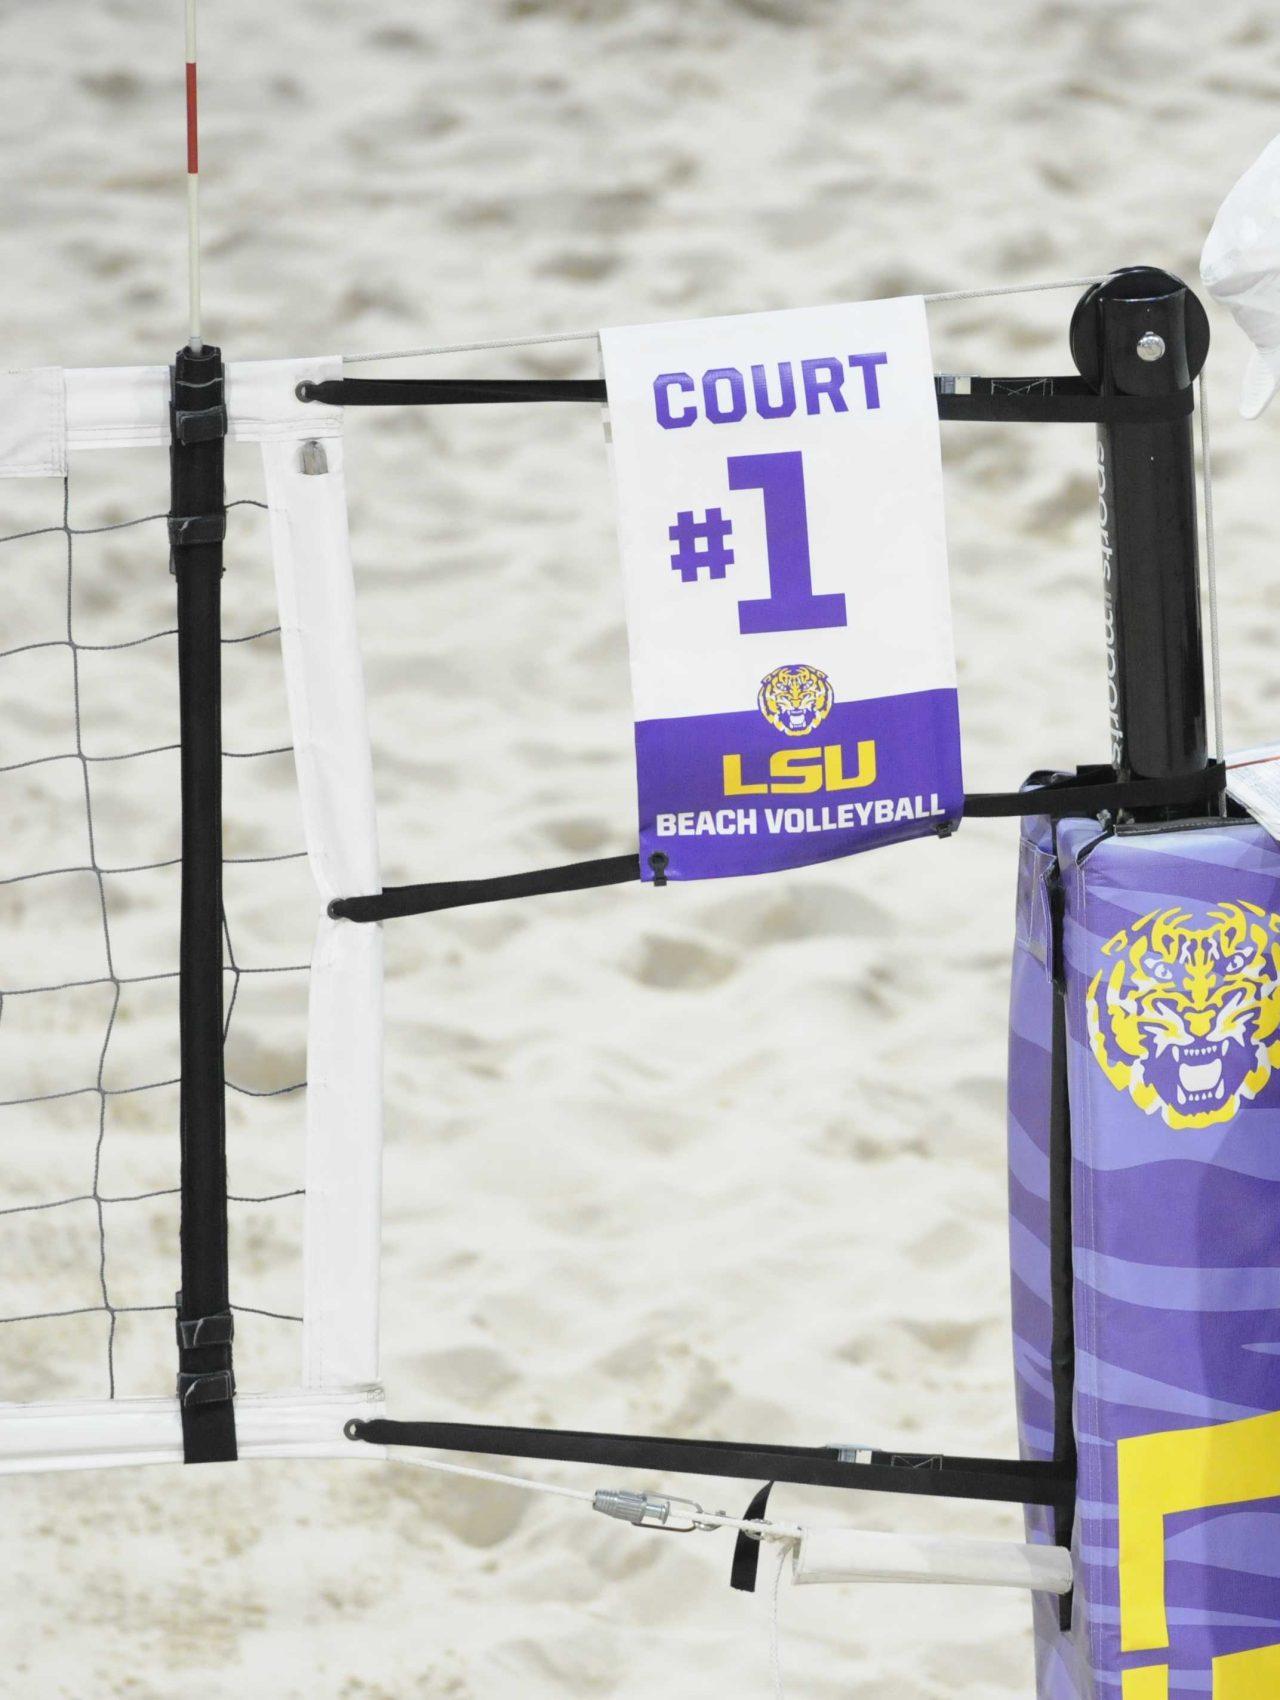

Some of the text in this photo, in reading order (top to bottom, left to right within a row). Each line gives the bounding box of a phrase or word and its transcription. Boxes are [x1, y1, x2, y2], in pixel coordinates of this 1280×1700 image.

[653, 351, 888, 430] COURT
[668, 450, 848, 635] #1
[722, 739, 878, 796] LSU
[655, 792, 946, 836] BEACH VOLLEYBALL
